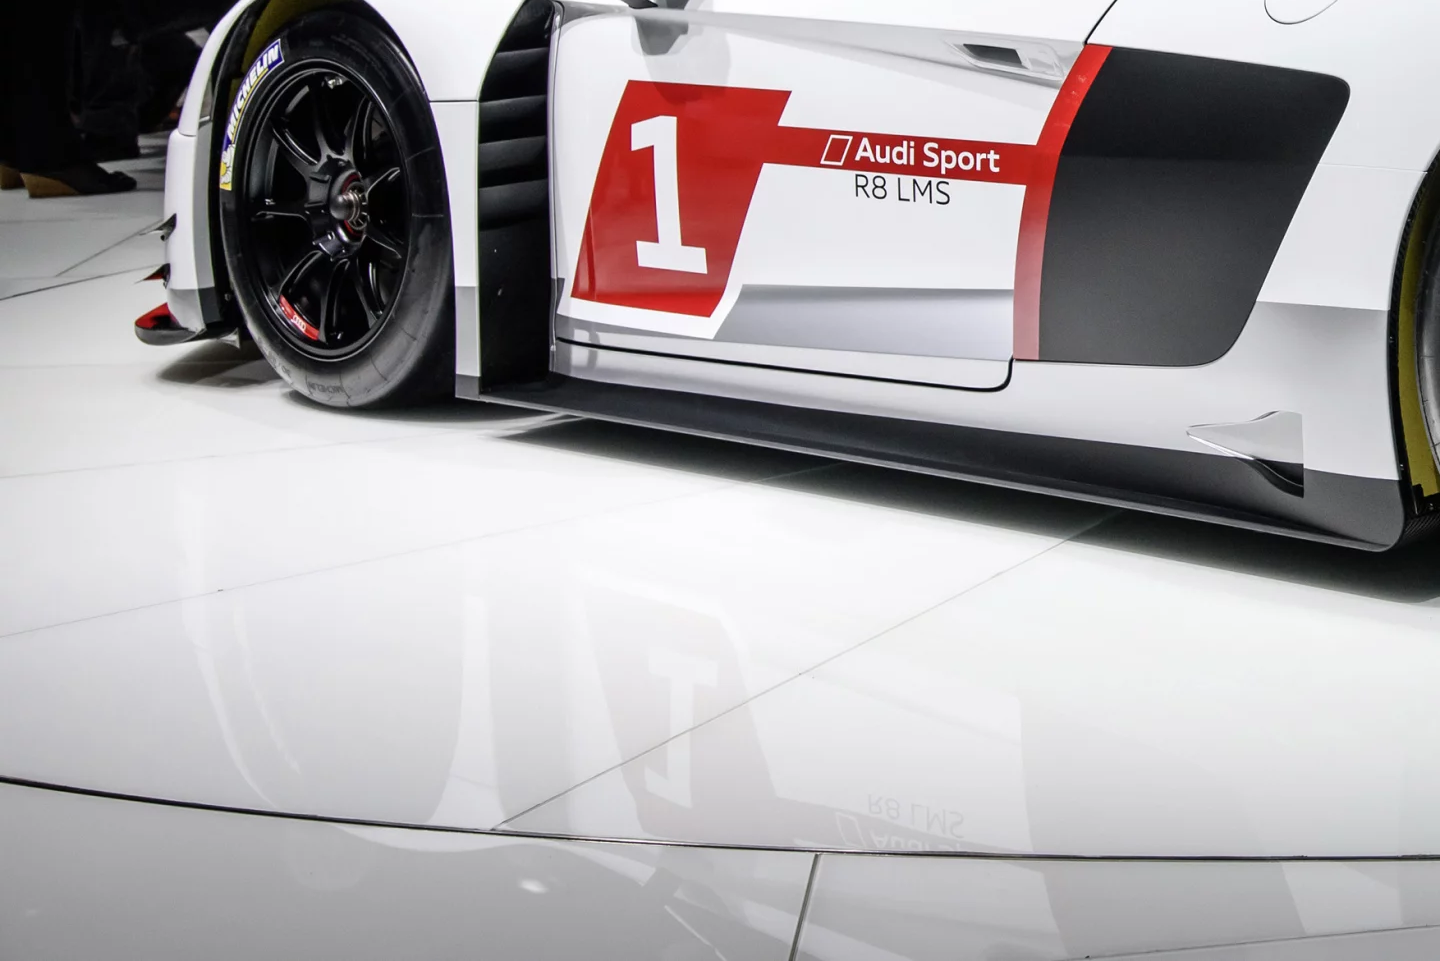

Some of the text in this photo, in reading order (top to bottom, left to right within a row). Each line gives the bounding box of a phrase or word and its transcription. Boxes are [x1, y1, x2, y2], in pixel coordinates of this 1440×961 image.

[226, 43, 279, 142] MICHELIN
[855, 137, 1000, 174] Audi Sport
[855, 173, 950, 205] R8 LMS
[630, 115, 708, 274] 1
